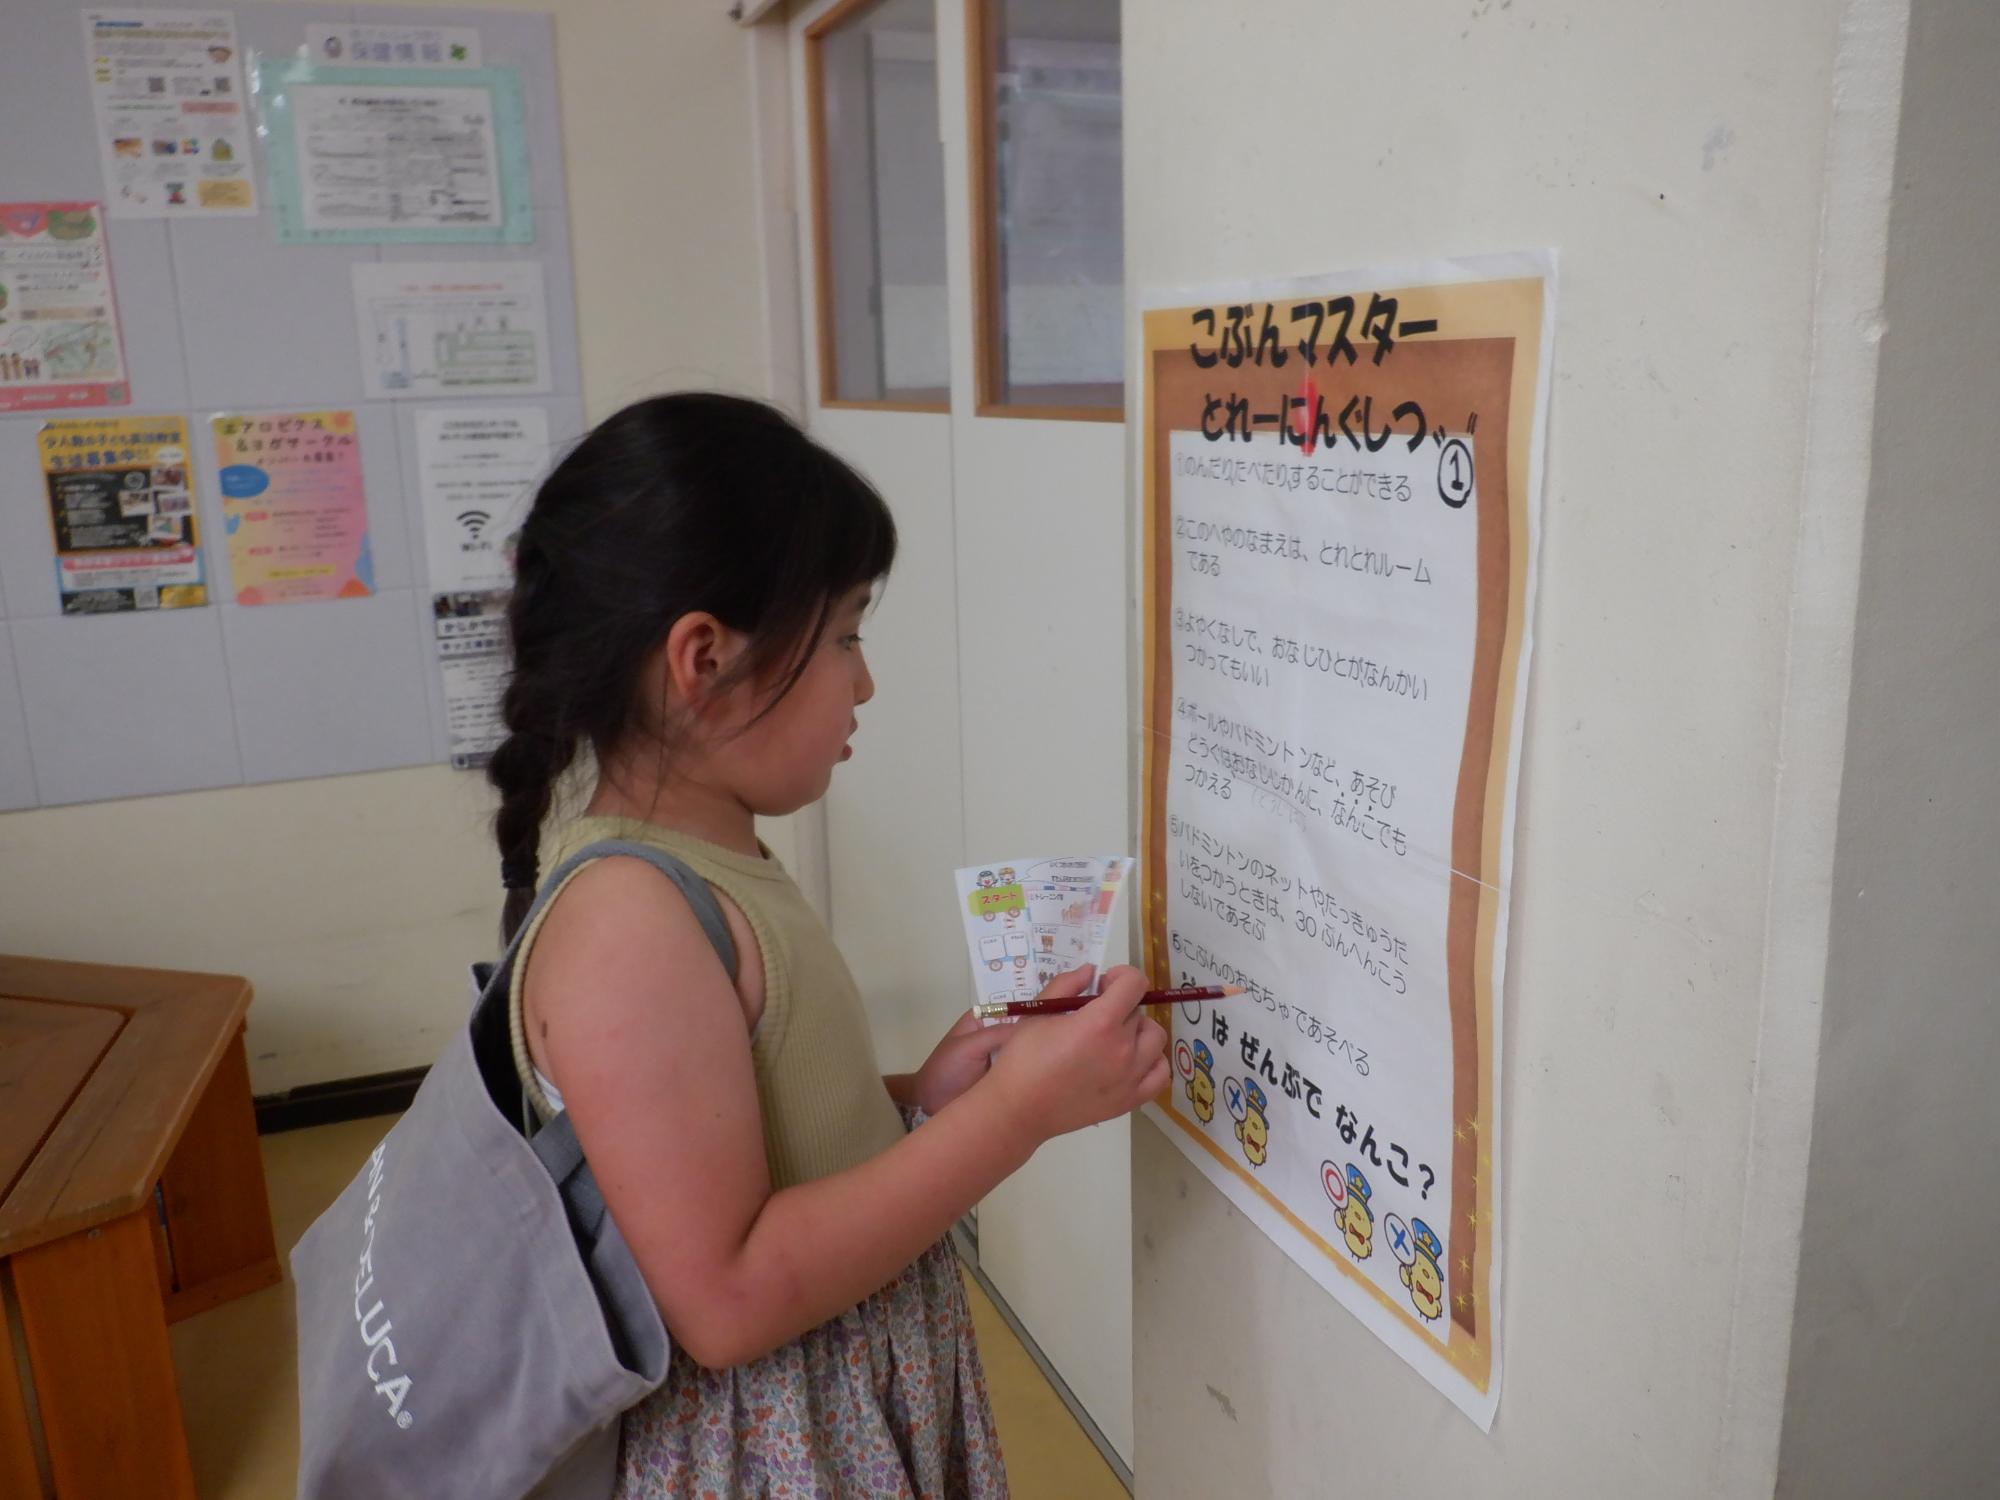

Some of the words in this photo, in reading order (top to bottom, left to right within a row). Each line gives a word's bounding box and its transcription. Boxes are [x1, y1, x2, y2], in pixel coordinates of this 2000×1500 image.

[1190, 292, 1438, 369] こぶんマスター
[1186, 550, 1221, 577] である
[1185, 644, 1270, 688] つかってもいい
[1184, 764, 1232, 800] つかえる
[982, 891, 1017, 905] スタート
[1240, 1031, 1323, 1119] ぜんぶで
